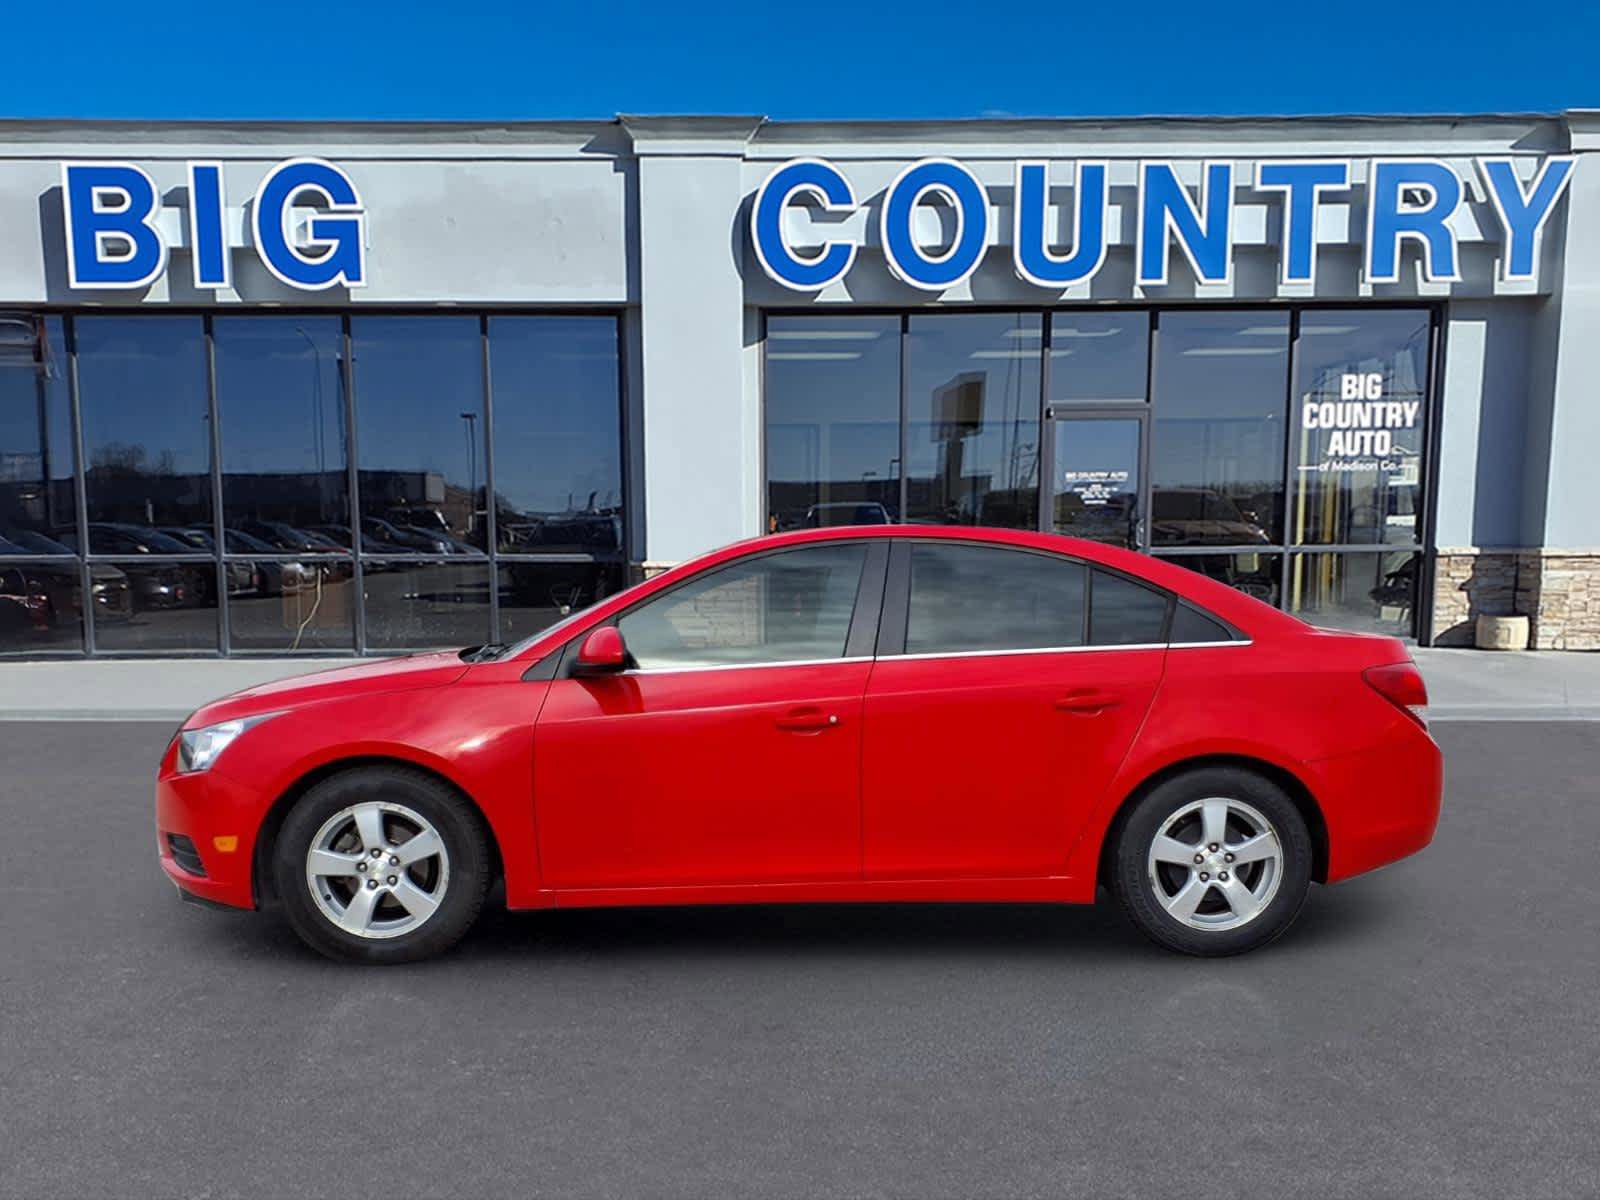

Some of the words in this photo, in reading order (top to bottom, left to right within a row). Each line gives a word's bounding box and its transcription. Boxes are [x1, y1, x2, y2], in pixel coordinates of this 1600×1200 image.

[60, 157, 368, 290] BIG
[750, 155, 1575, 291] COUNTRY
[1341, 373, 1383, 400] BIG
[1303, 401, 1419, 428] COUNTRY
[1327, 430, 1392, 457] AUTO
[1319, 460, 1331, 472] of
[1331, 460, 1378, 471] Madison
[1380, 460, 1399, 470] Co.
